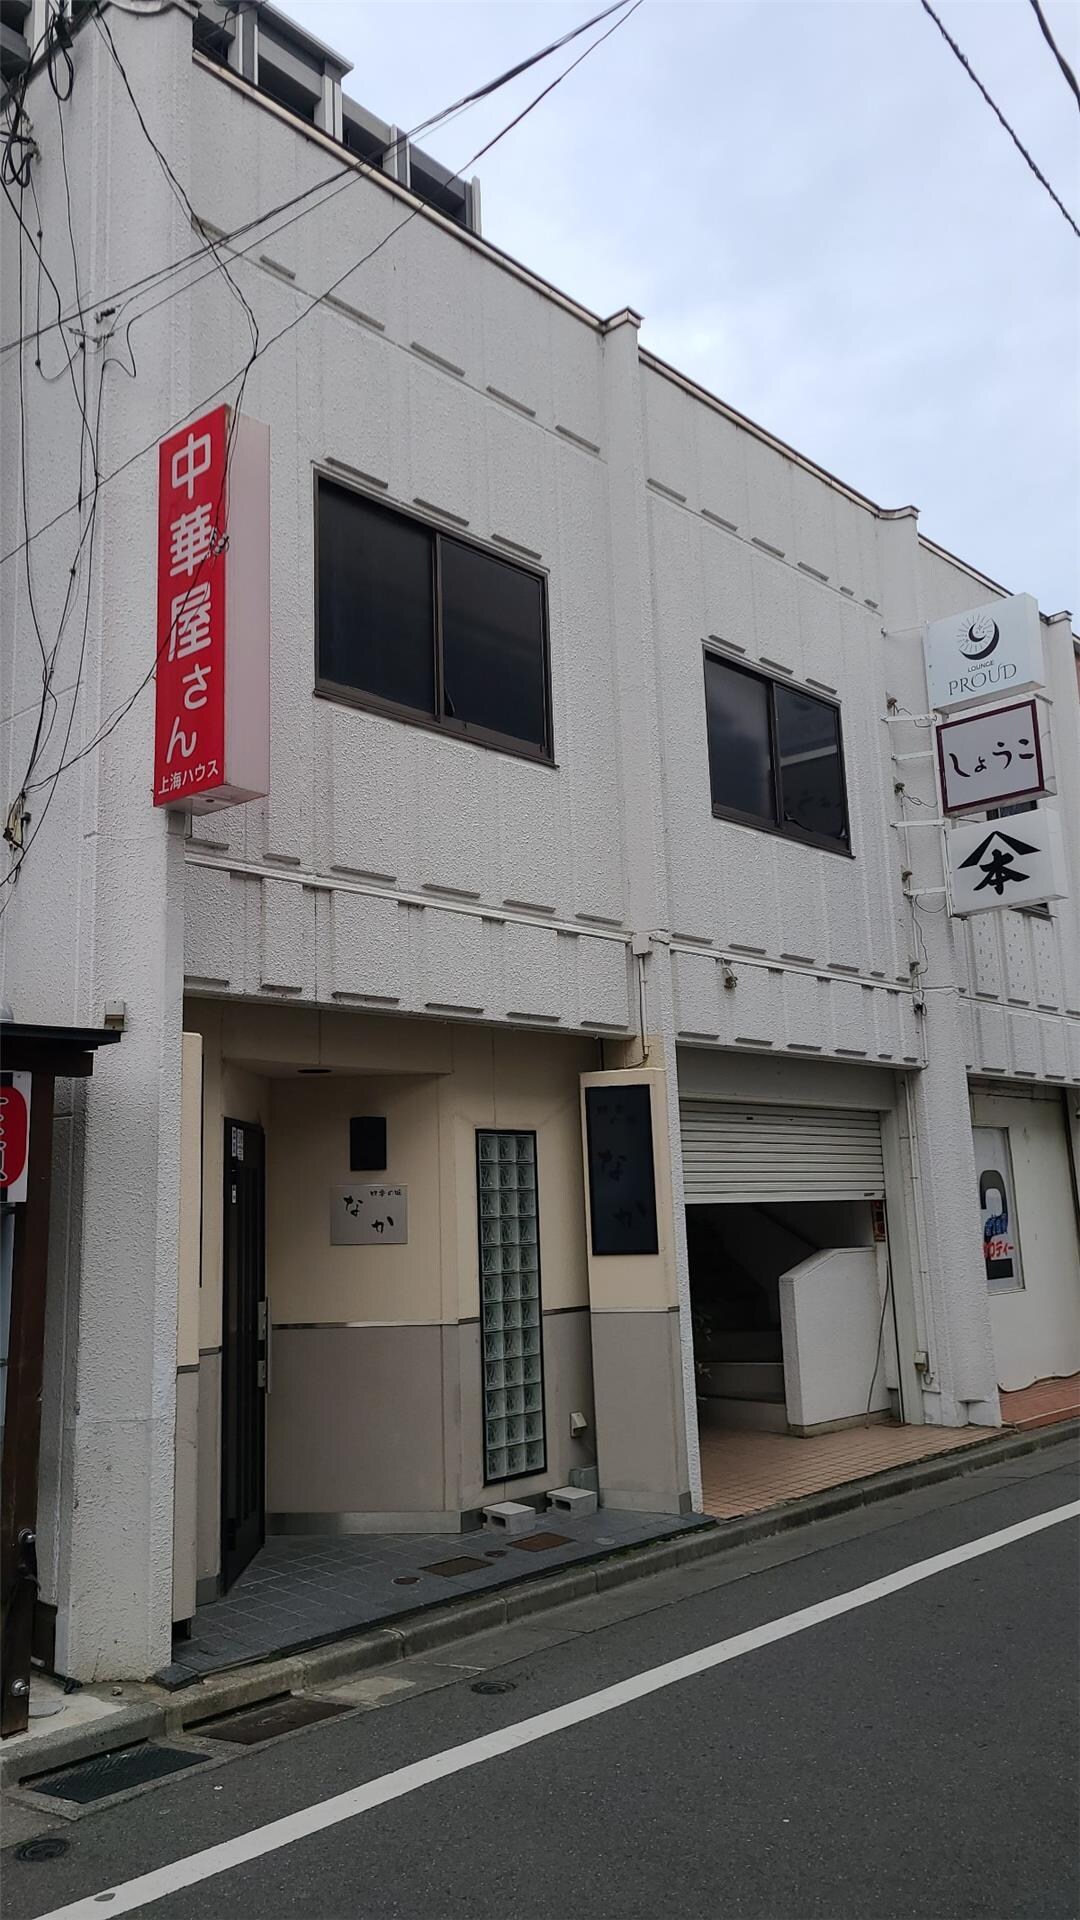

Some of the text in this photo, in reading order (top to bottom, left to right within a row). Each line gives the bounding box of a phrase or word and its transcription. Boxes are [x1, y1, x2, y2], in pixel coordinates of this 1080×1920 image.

[166, 432, 213, 764] 中華屋さん
[949, 663, 1017, 696] PROUD
[967, 660, 994, 673] LOUNGE
[949, 738, 1035, 778] しょうこ
[158, 759, 219, 795] 上海ハウス
